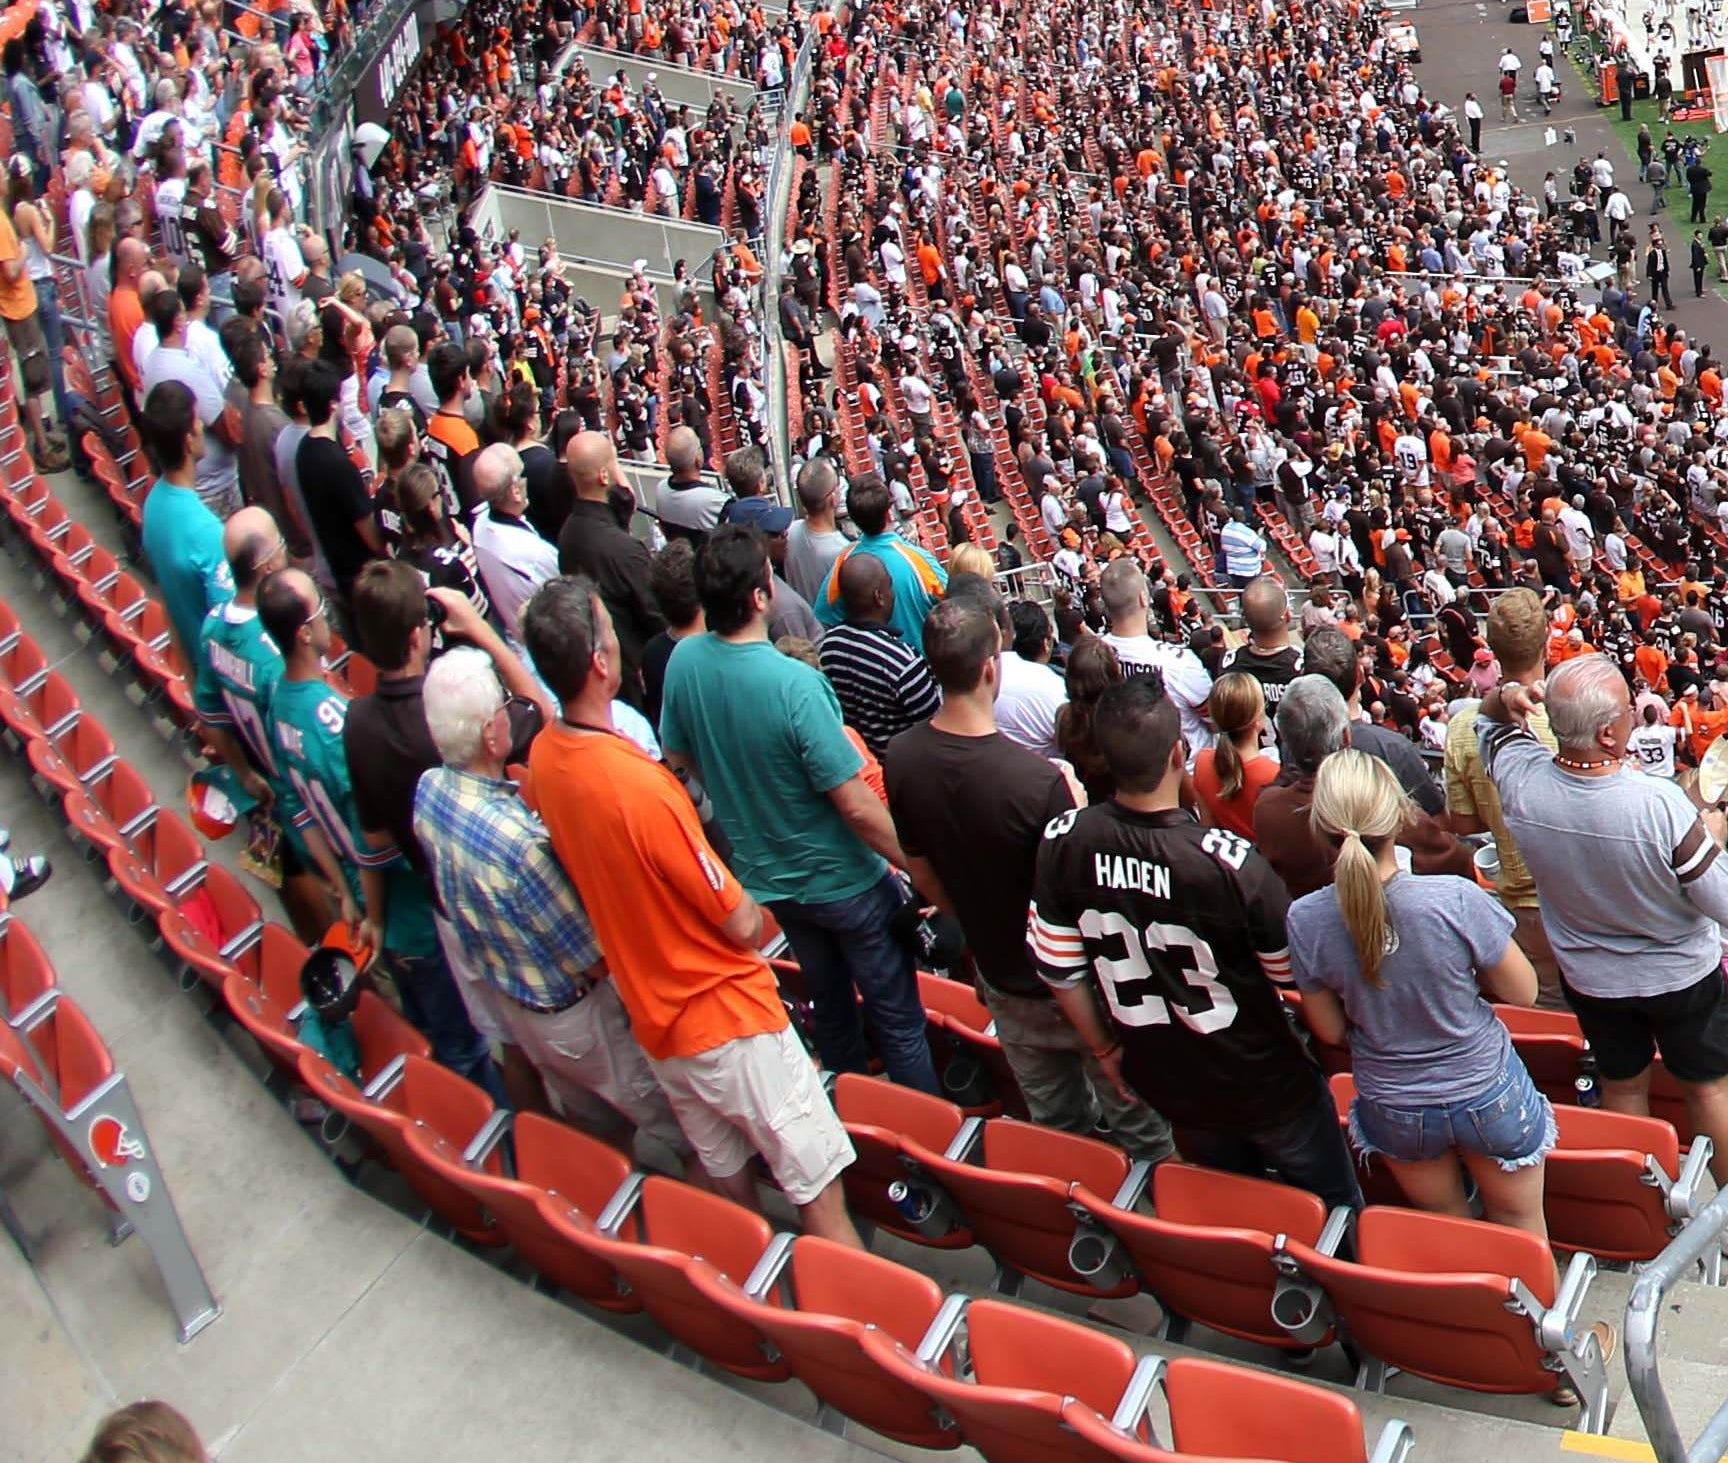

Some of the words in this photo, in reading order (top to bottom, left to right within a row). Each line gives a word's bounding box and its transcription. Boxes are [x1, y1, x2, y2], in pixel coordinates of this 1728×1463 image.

[1399, 451, 1420, 471] 19
[1641, 747, 1666, 765] 33
[1095, 853, 1171, 901] HADEN
[1078, 907, 1239, 1036] 23
